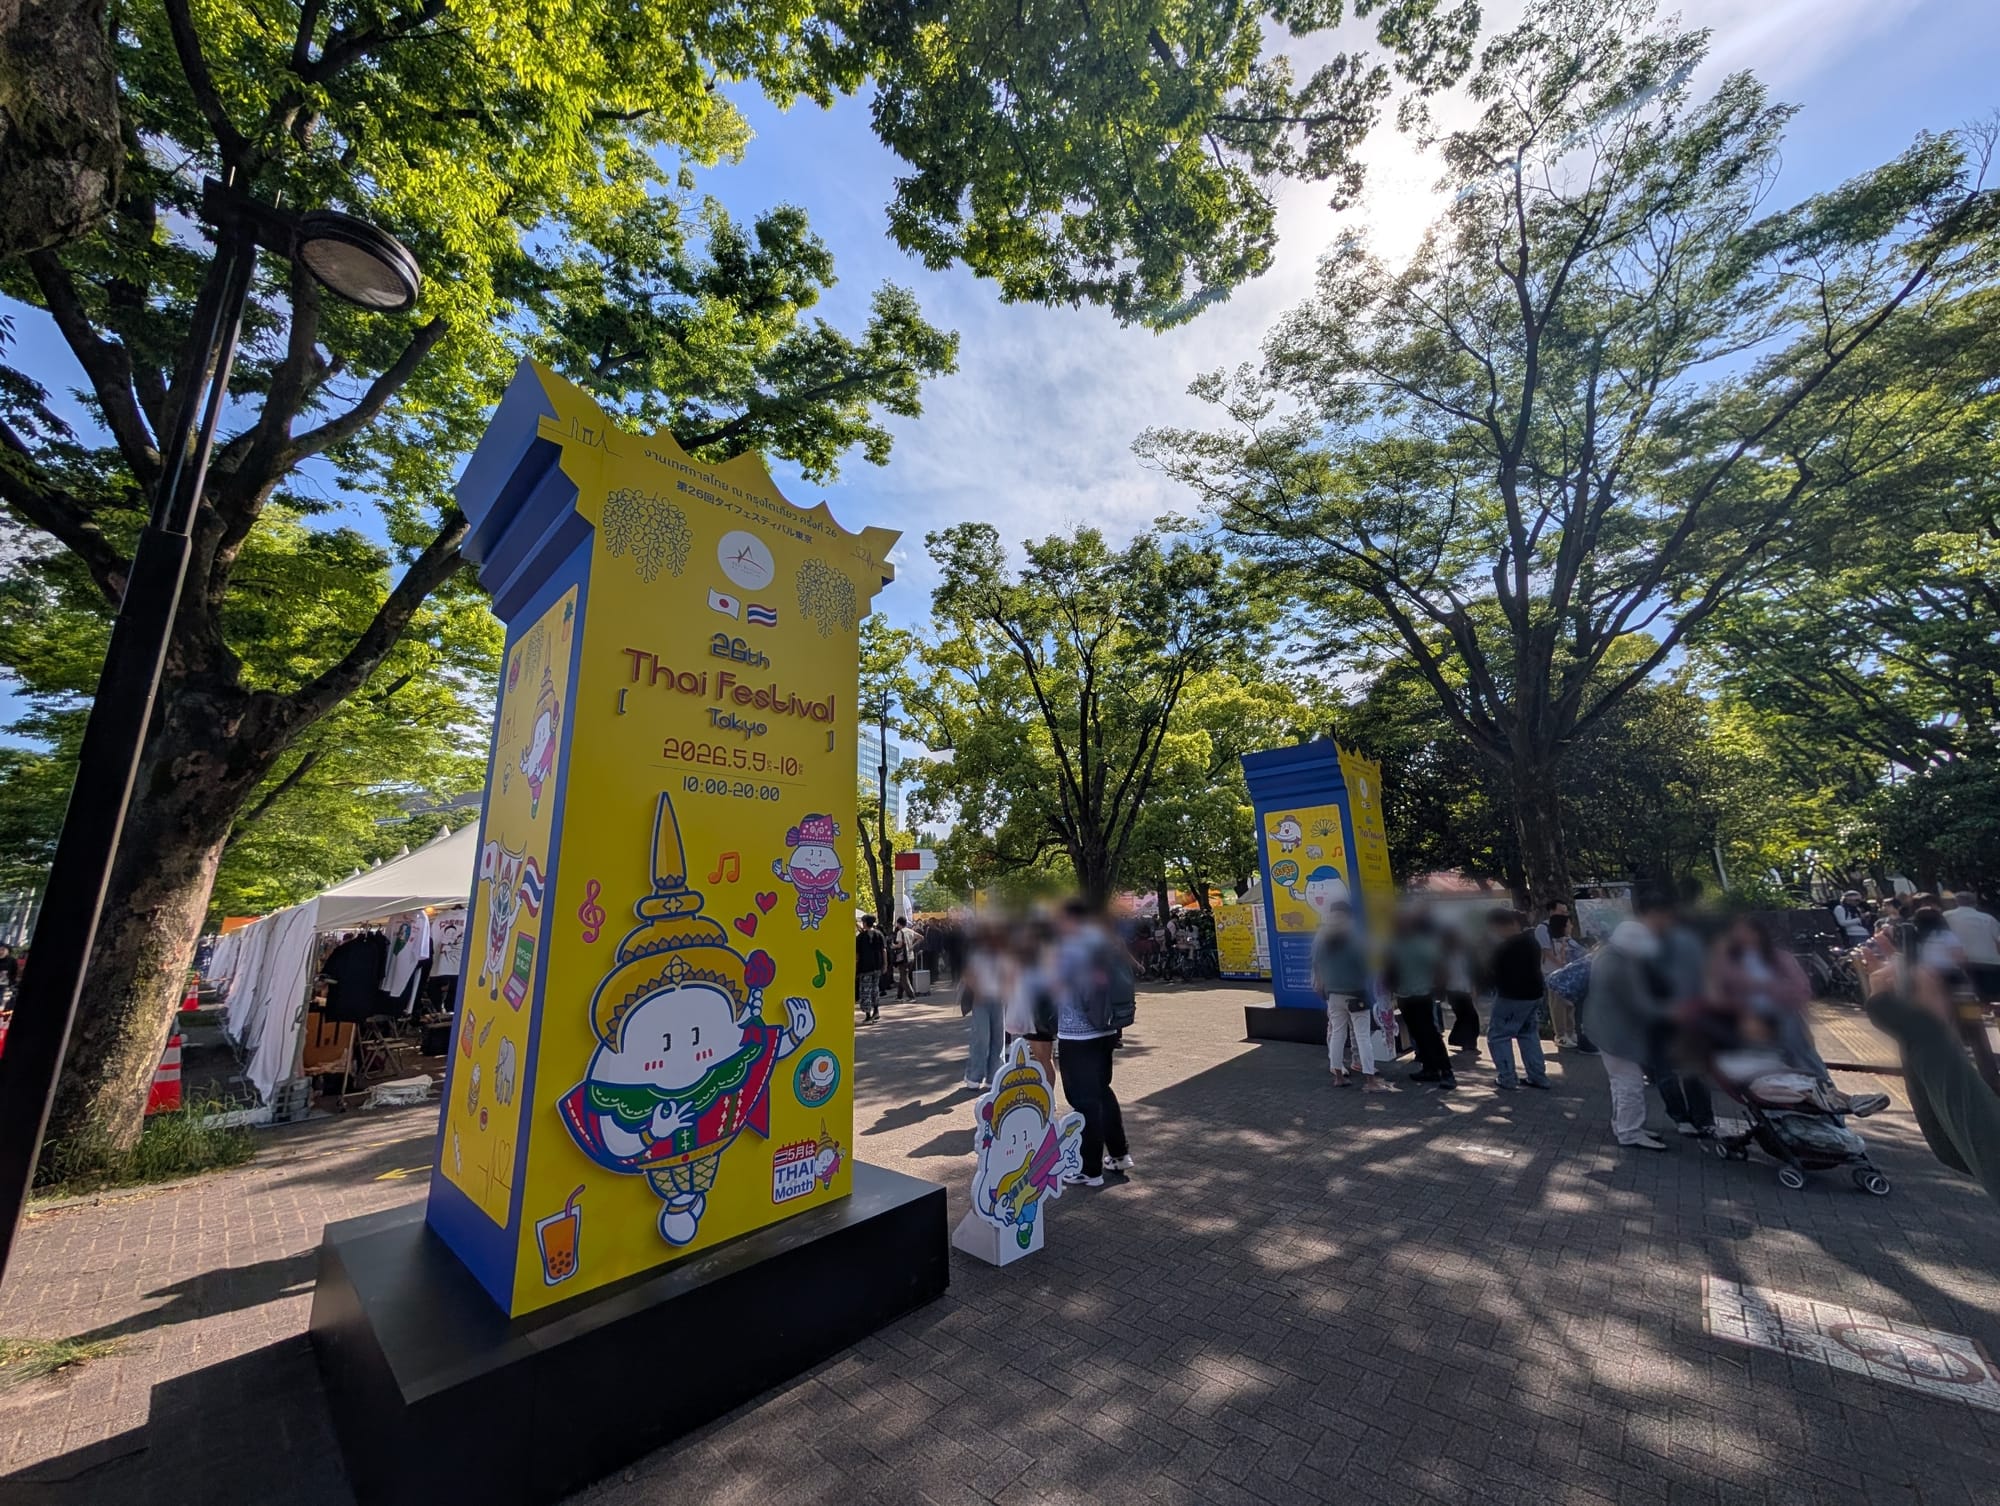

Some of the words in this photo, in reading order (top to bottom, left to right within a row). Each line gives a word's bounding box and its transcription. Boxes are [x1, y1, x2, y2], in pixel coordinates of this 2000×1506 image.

[644, 449, 729, 491] งานเทศกาลไทย
[732, 487, 743, 497] ณ
[746, 492, 797, 520] กรุงโตเกียว
[825, 526, 838, 538] 26
[676, 480, 814, 545] 第26回タイフェスティバル東京
[711, 633, 770, 669] 26th
[624, 647, 707, 696] Thai
[716, 670, 835, 724] Festival
[706, 707, 768, 740] Tokyo
[682, 775, 780, 802] 10:00-20:00
[787, 1143, 816, 1161] 5月は
[775, 1159, 814, 1184] THAI
[775, 1179, 813, 1201] Month
